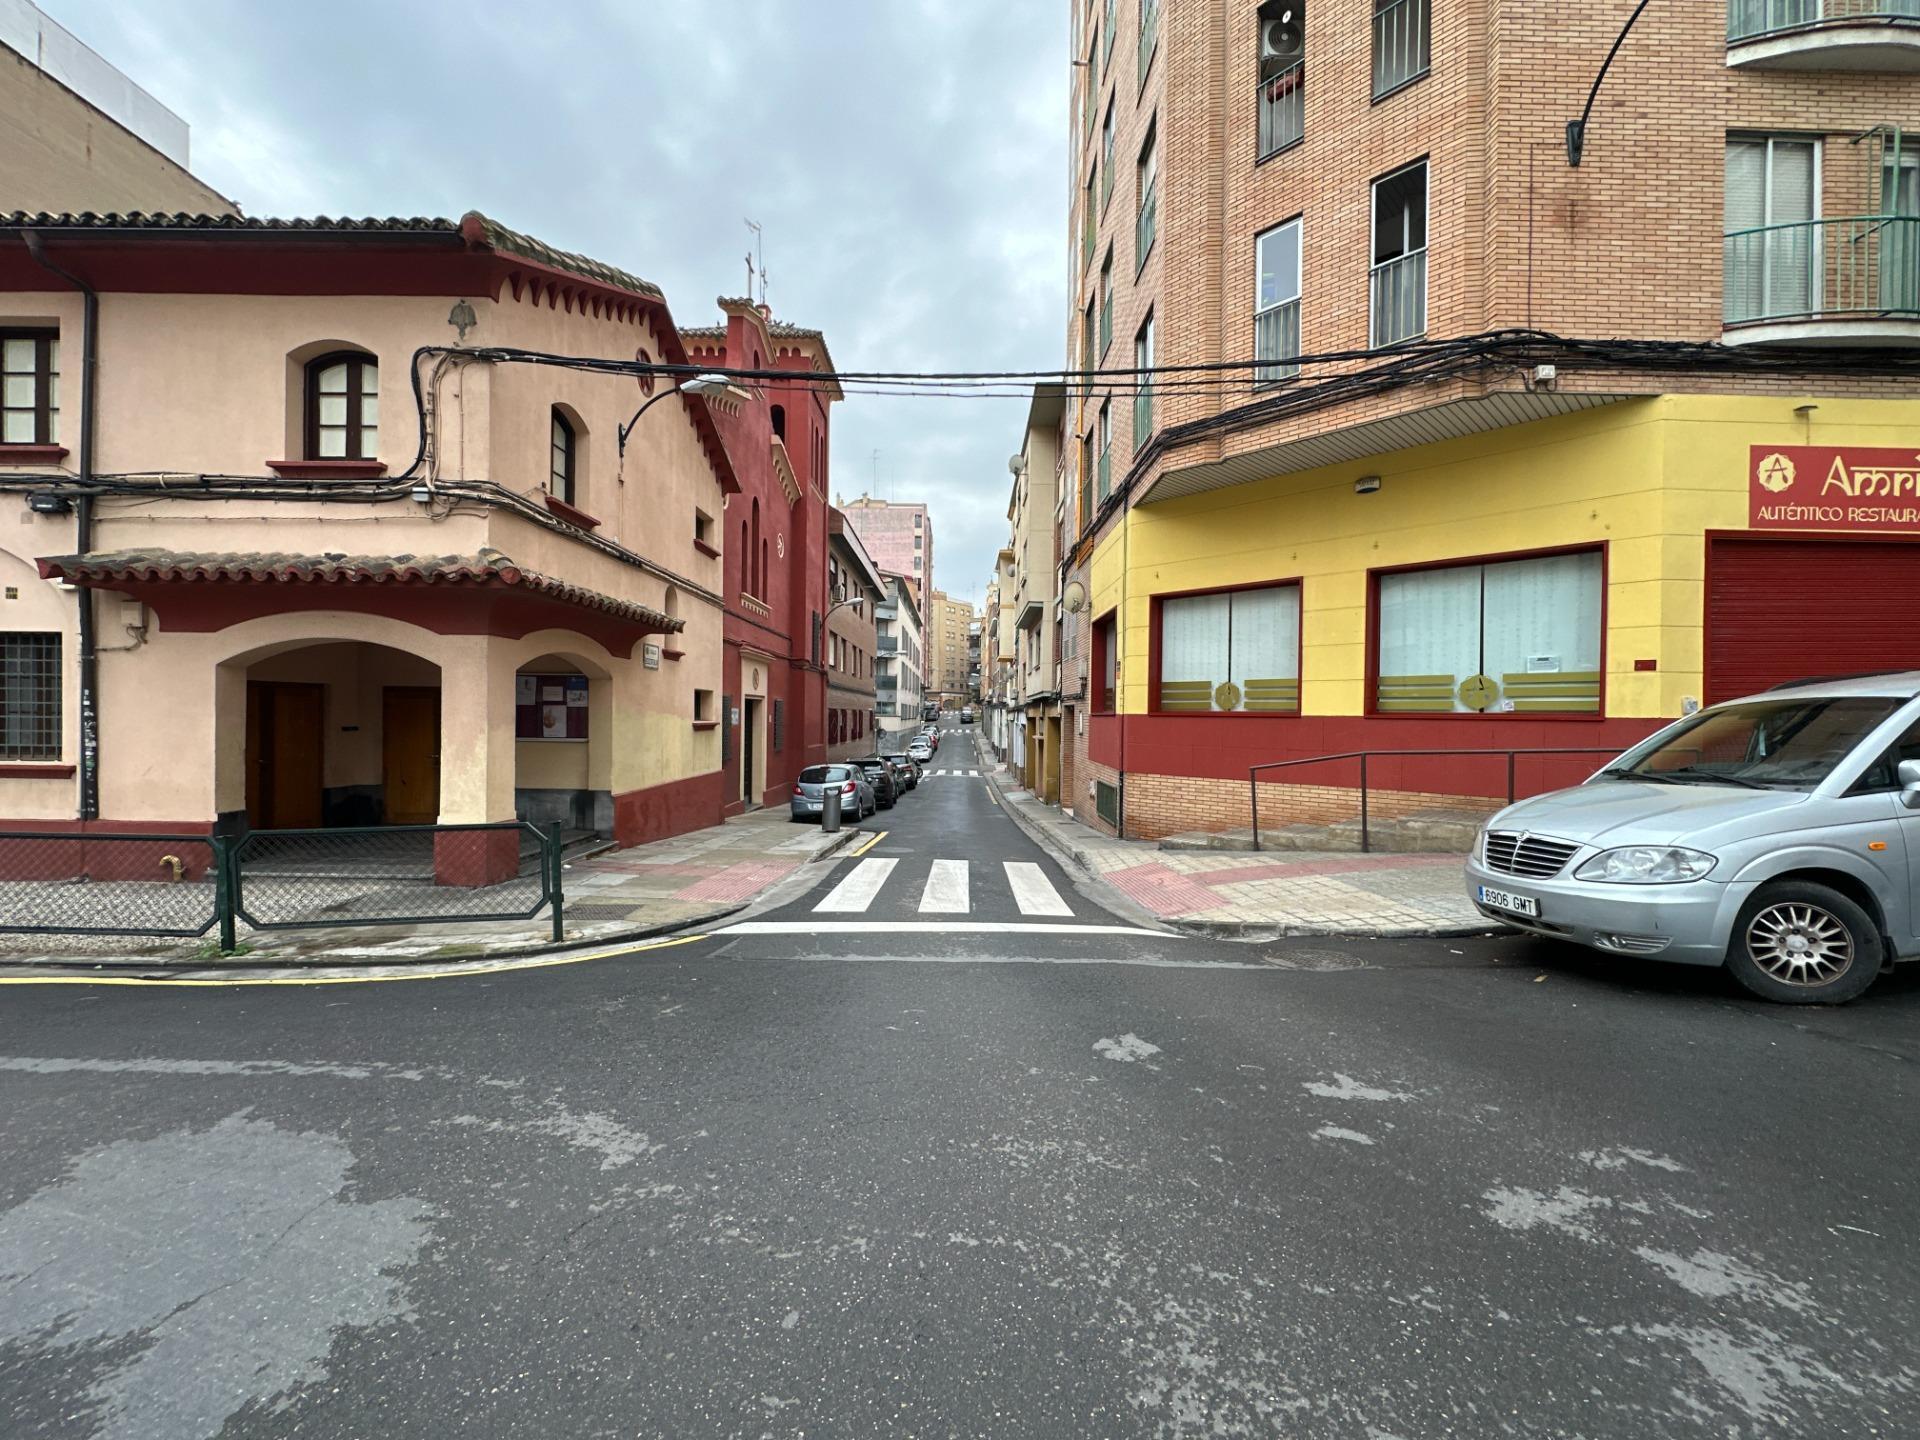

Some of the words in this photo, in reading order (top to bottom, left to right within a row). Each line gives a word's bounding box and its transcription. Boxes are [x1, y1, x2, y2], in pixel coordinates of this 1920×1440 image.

[1847, 506, 1920, 523] RESTAUR
[1485, 889, 1509, 907] 6906
[1512, 896, 1533, 913] GMT
